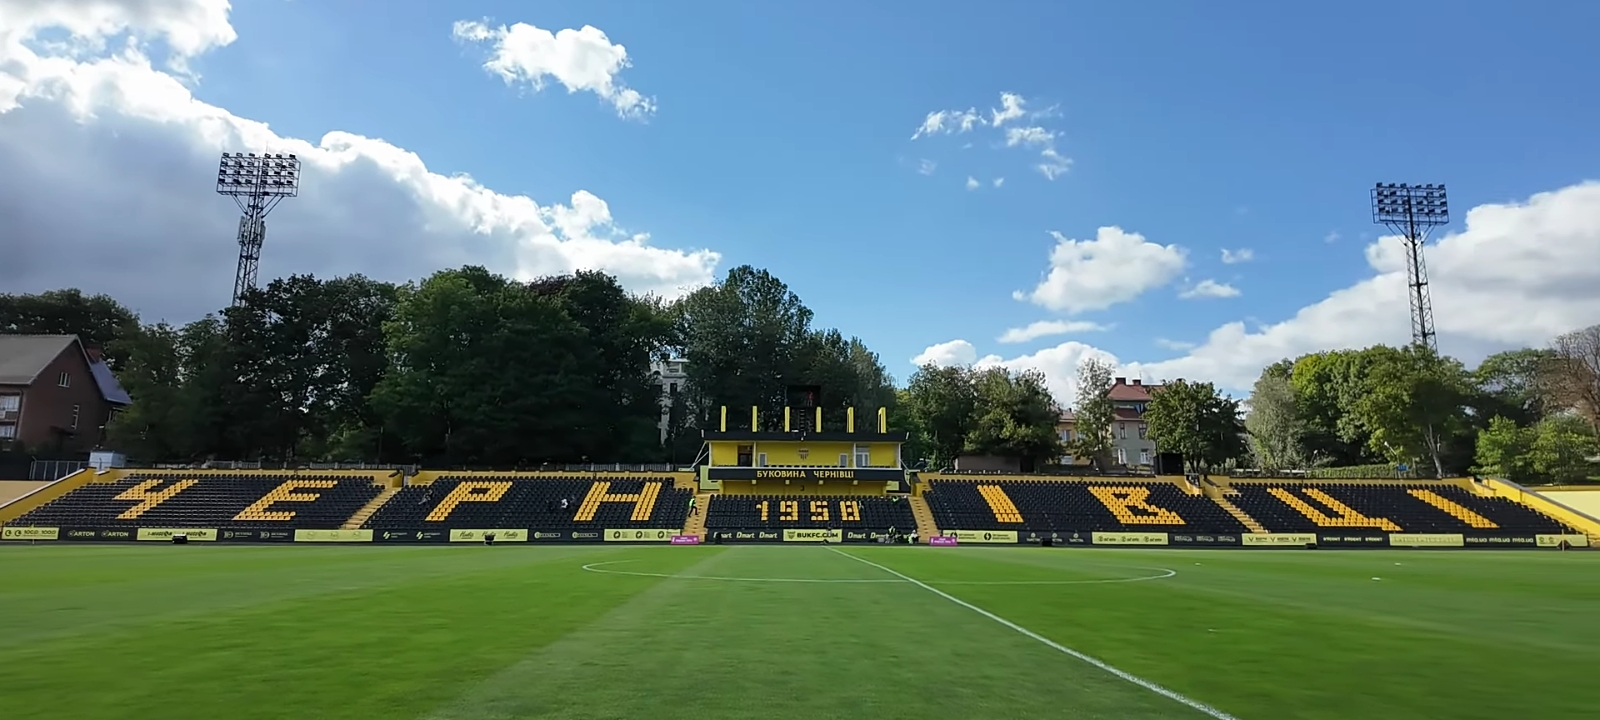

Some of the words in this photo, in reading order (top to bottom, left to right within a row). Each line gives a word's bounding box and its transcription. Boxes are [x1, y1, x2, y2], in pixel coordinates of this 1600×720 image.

[756, 470, 806, 478] БУКОВИНА
[813, 470, 854, 479] ЧЕРНІВЦІ
[755, 500, 861, 521] 1958
[736, 531, 755, 539] Dmart
[759, 531, 778, 539] Dmart
[847, 531, 867, 539] Dmart
